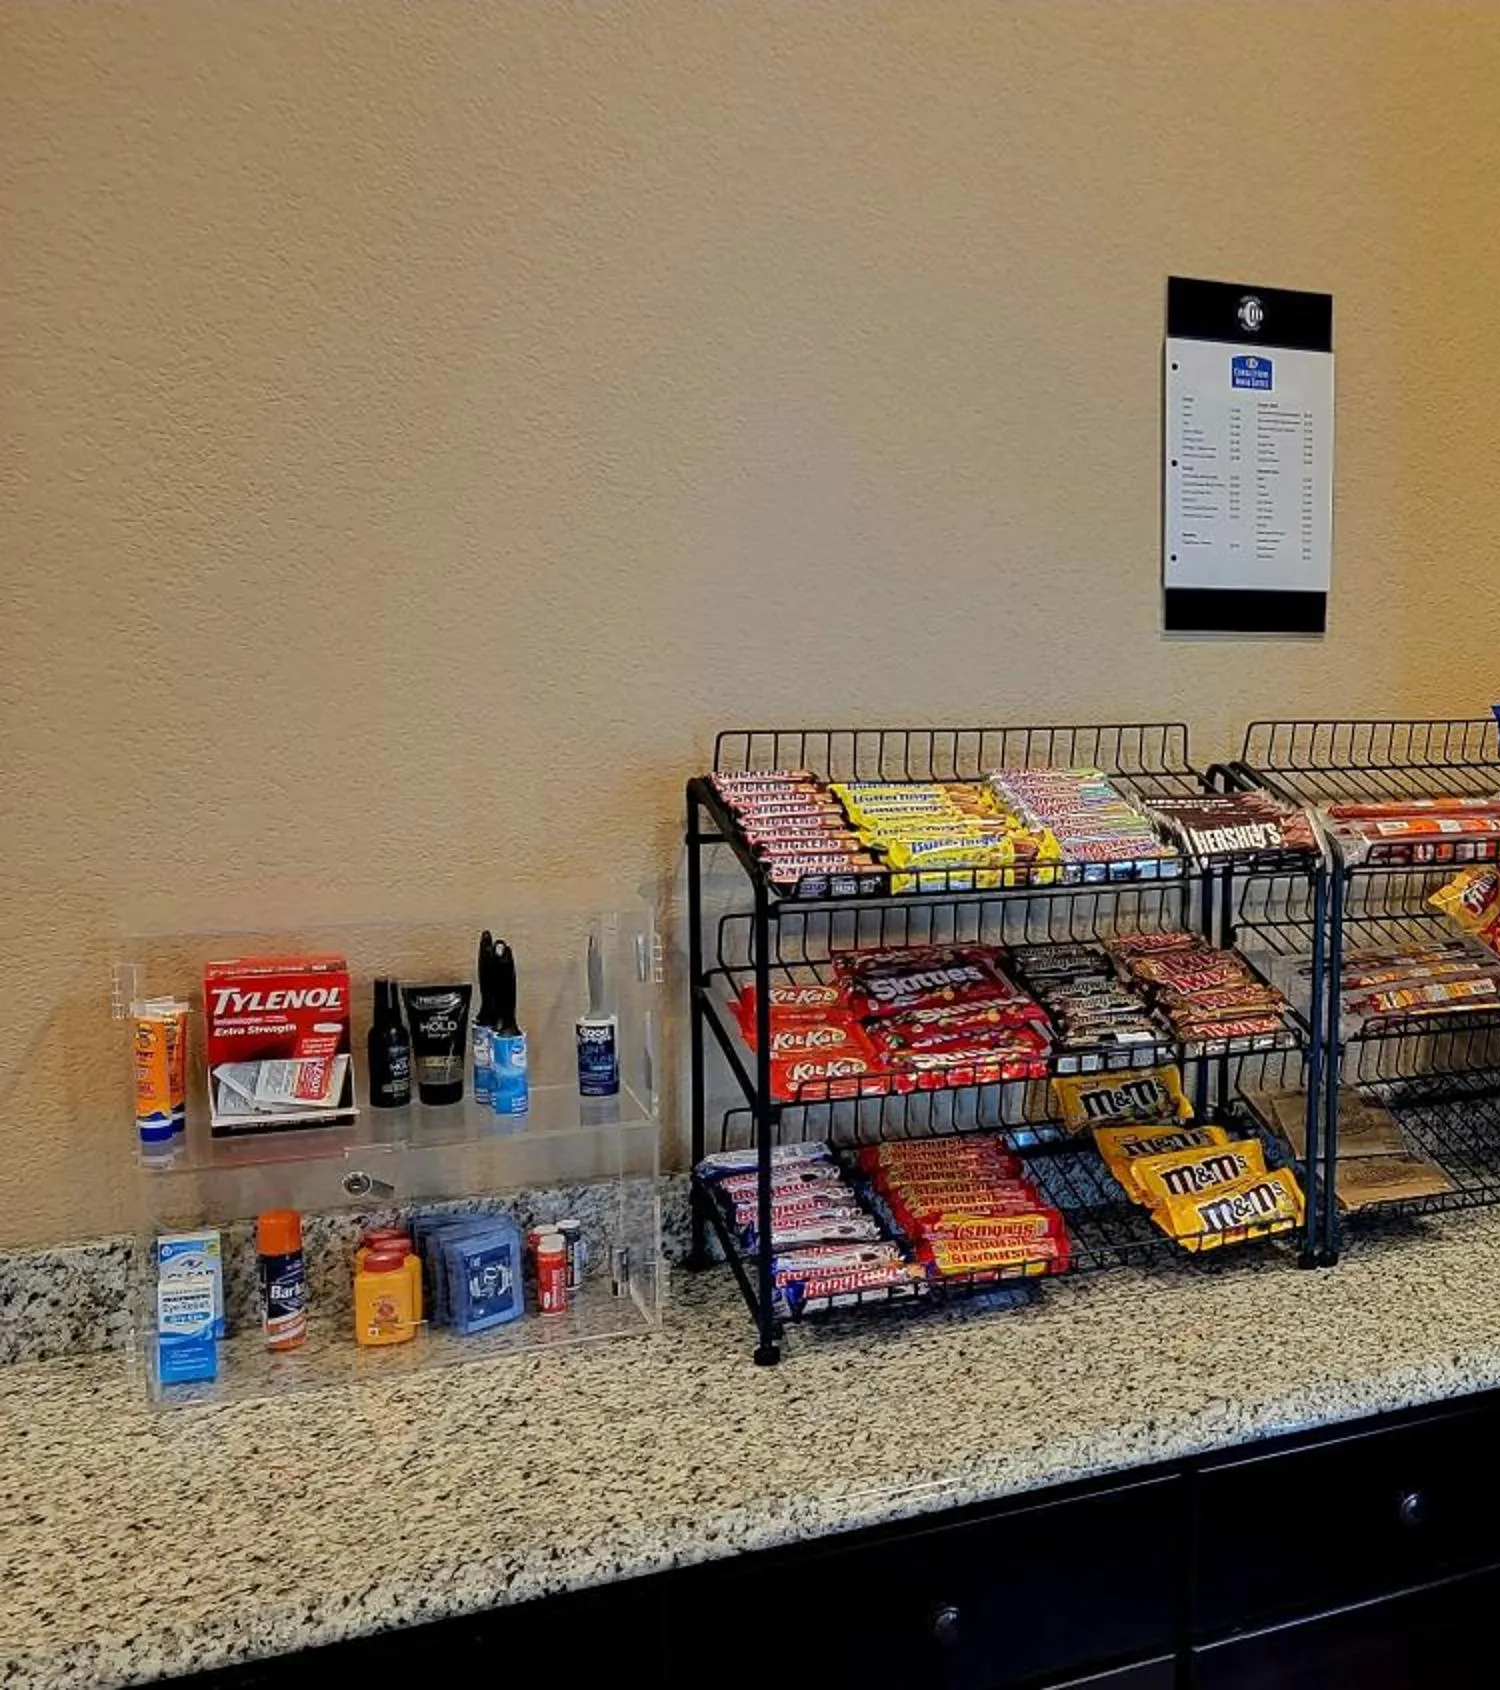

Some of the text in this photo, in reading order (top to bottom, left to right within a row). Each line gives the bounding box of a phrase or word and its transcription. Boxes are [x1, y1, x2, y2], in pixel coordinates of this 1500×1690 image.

[1190, 823, 1281, 853] HERSHEY'S
[870, 966, 983, 1000] Skittles
[211, 987, 342, 1016] TYLENOL
[213, 1023, 297, 1037] Extra Strength
[420, 1021, 458, 1034] HOLD
